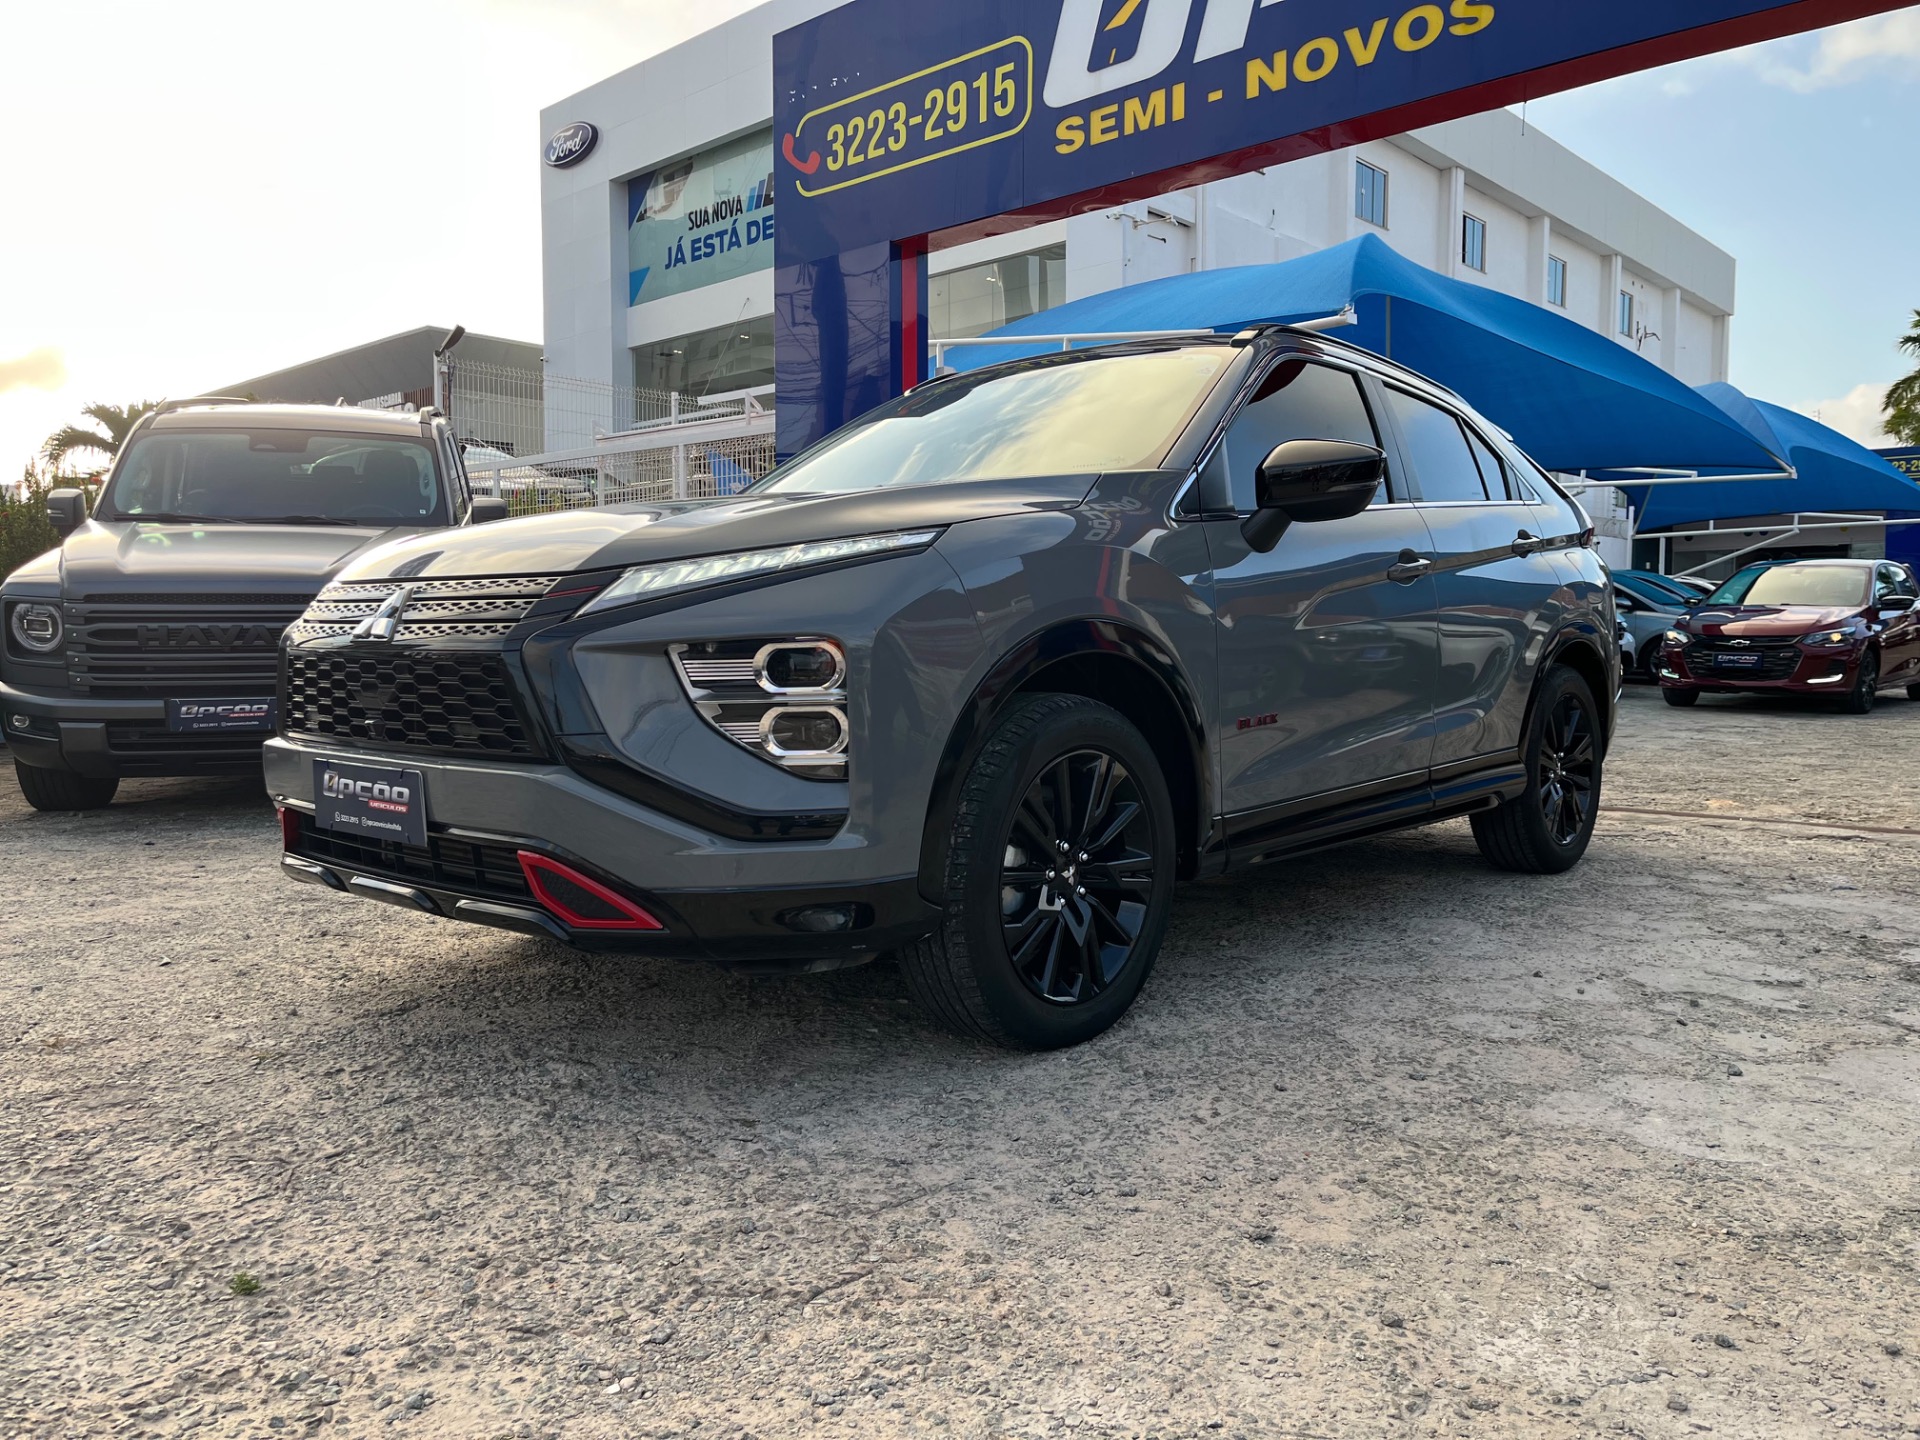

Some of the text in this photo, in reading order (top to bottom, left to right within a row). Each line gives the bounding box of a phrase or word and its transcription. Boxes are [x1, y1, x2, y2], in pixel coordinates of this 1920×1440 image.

[1054, 82, 1185, 155] SEMI
[1246, 0, 1495, 99] NOVOS
[826, 62, 1015, 171] 3223-2915
[549, 128, 582, 161] Ford
[688, 194, 743, 231] SUA NOVA
[664, 236, 687, 270] JÁ
[690, 218, 742, 263] ESTÁ
[1236, 711, 1279, 731] BLACK
